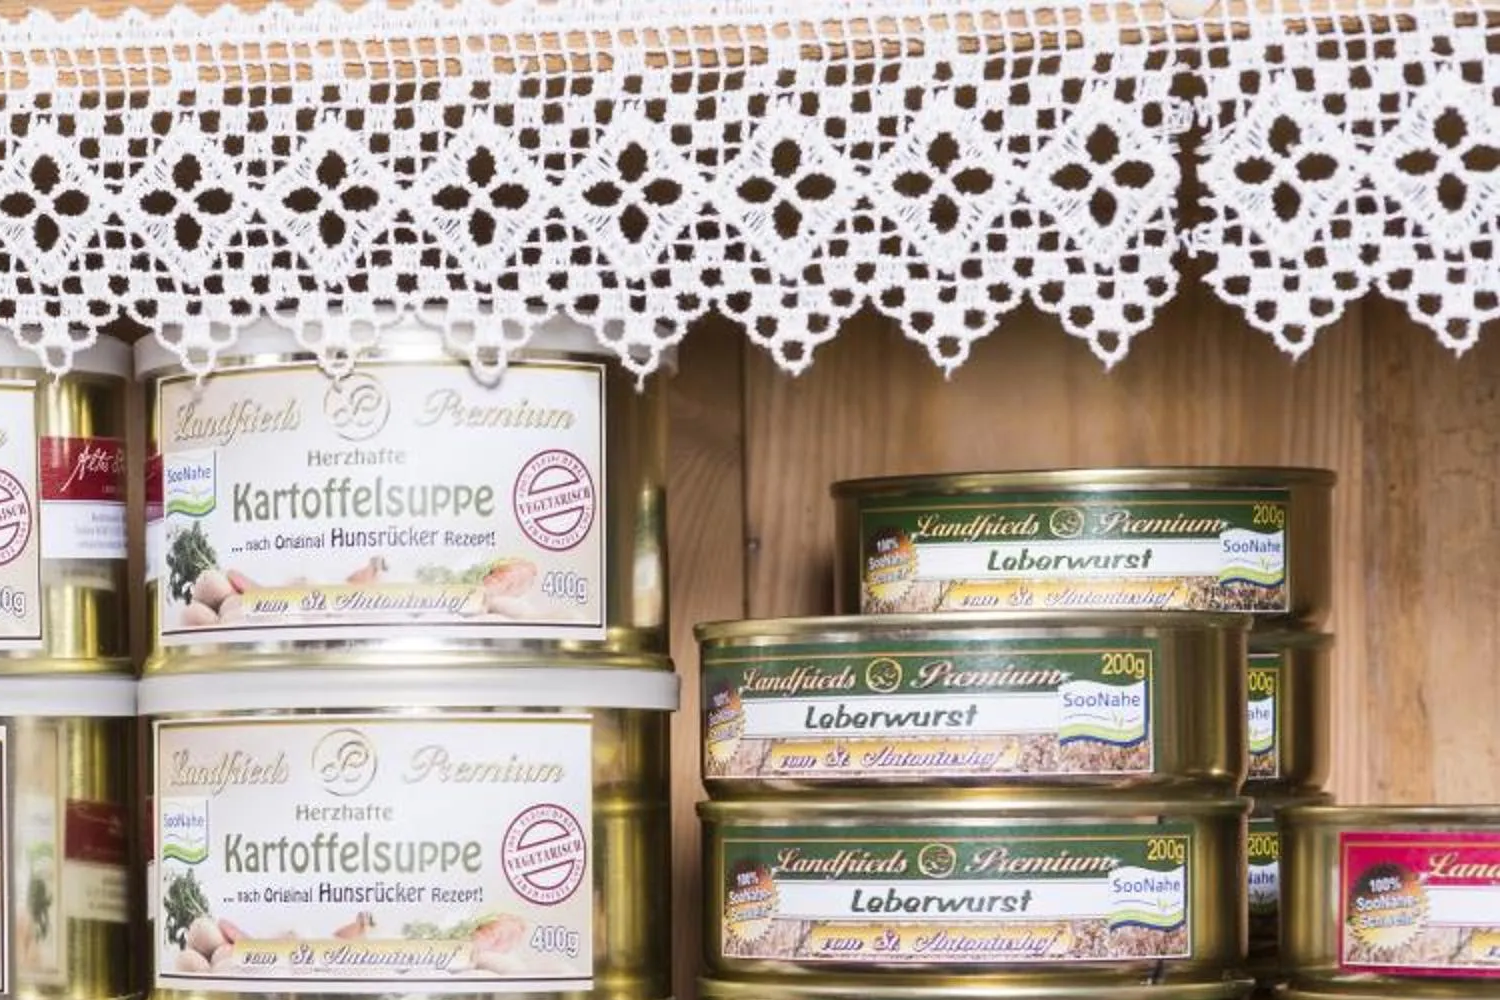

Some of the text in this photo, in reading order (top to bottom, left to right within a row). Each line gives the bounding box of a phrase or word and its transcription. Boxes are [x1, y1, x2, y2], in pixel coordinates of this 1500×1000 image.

[415, 388, 577, 431] Premium
[307, 448, 407, 467] Herzhafte
[233, 477, 495, 523] Kartoffelsuppe
[1091, 509, 1225, 535] Premium
[1253, 504, 1285, 527] 200g
[330, 526, 496, 548] Hunsrücker Rezept!
[1223, 537, 1281, 555] SooNahe
[988, 547, 1155, 573] Leberwurst
[541, 571, 589, 602] 400g
[909, 661, 1064, 688] Premium
[1102, 653, 1146, 678] 200g
[1063, 691, 1141, 709] SooNahe
[805, 704, 978, 731] Leberwurst
[402, 744, 565, 785] Premium
[296, 803, 394, 821] Herzhafte
[224, 832, 483, 875] Kartoffelsuppe
[965, 846, 1115, 875] Premium
[1147, 839, 1186, 864] 200g
[319, 881, 483, 904] Hunsrücker Rezept!
[1112, 876, 1181, 895] SooNahe
[851, 887, 1033, 915] Leberwurst
[529, 925, 581, 958] 400g
